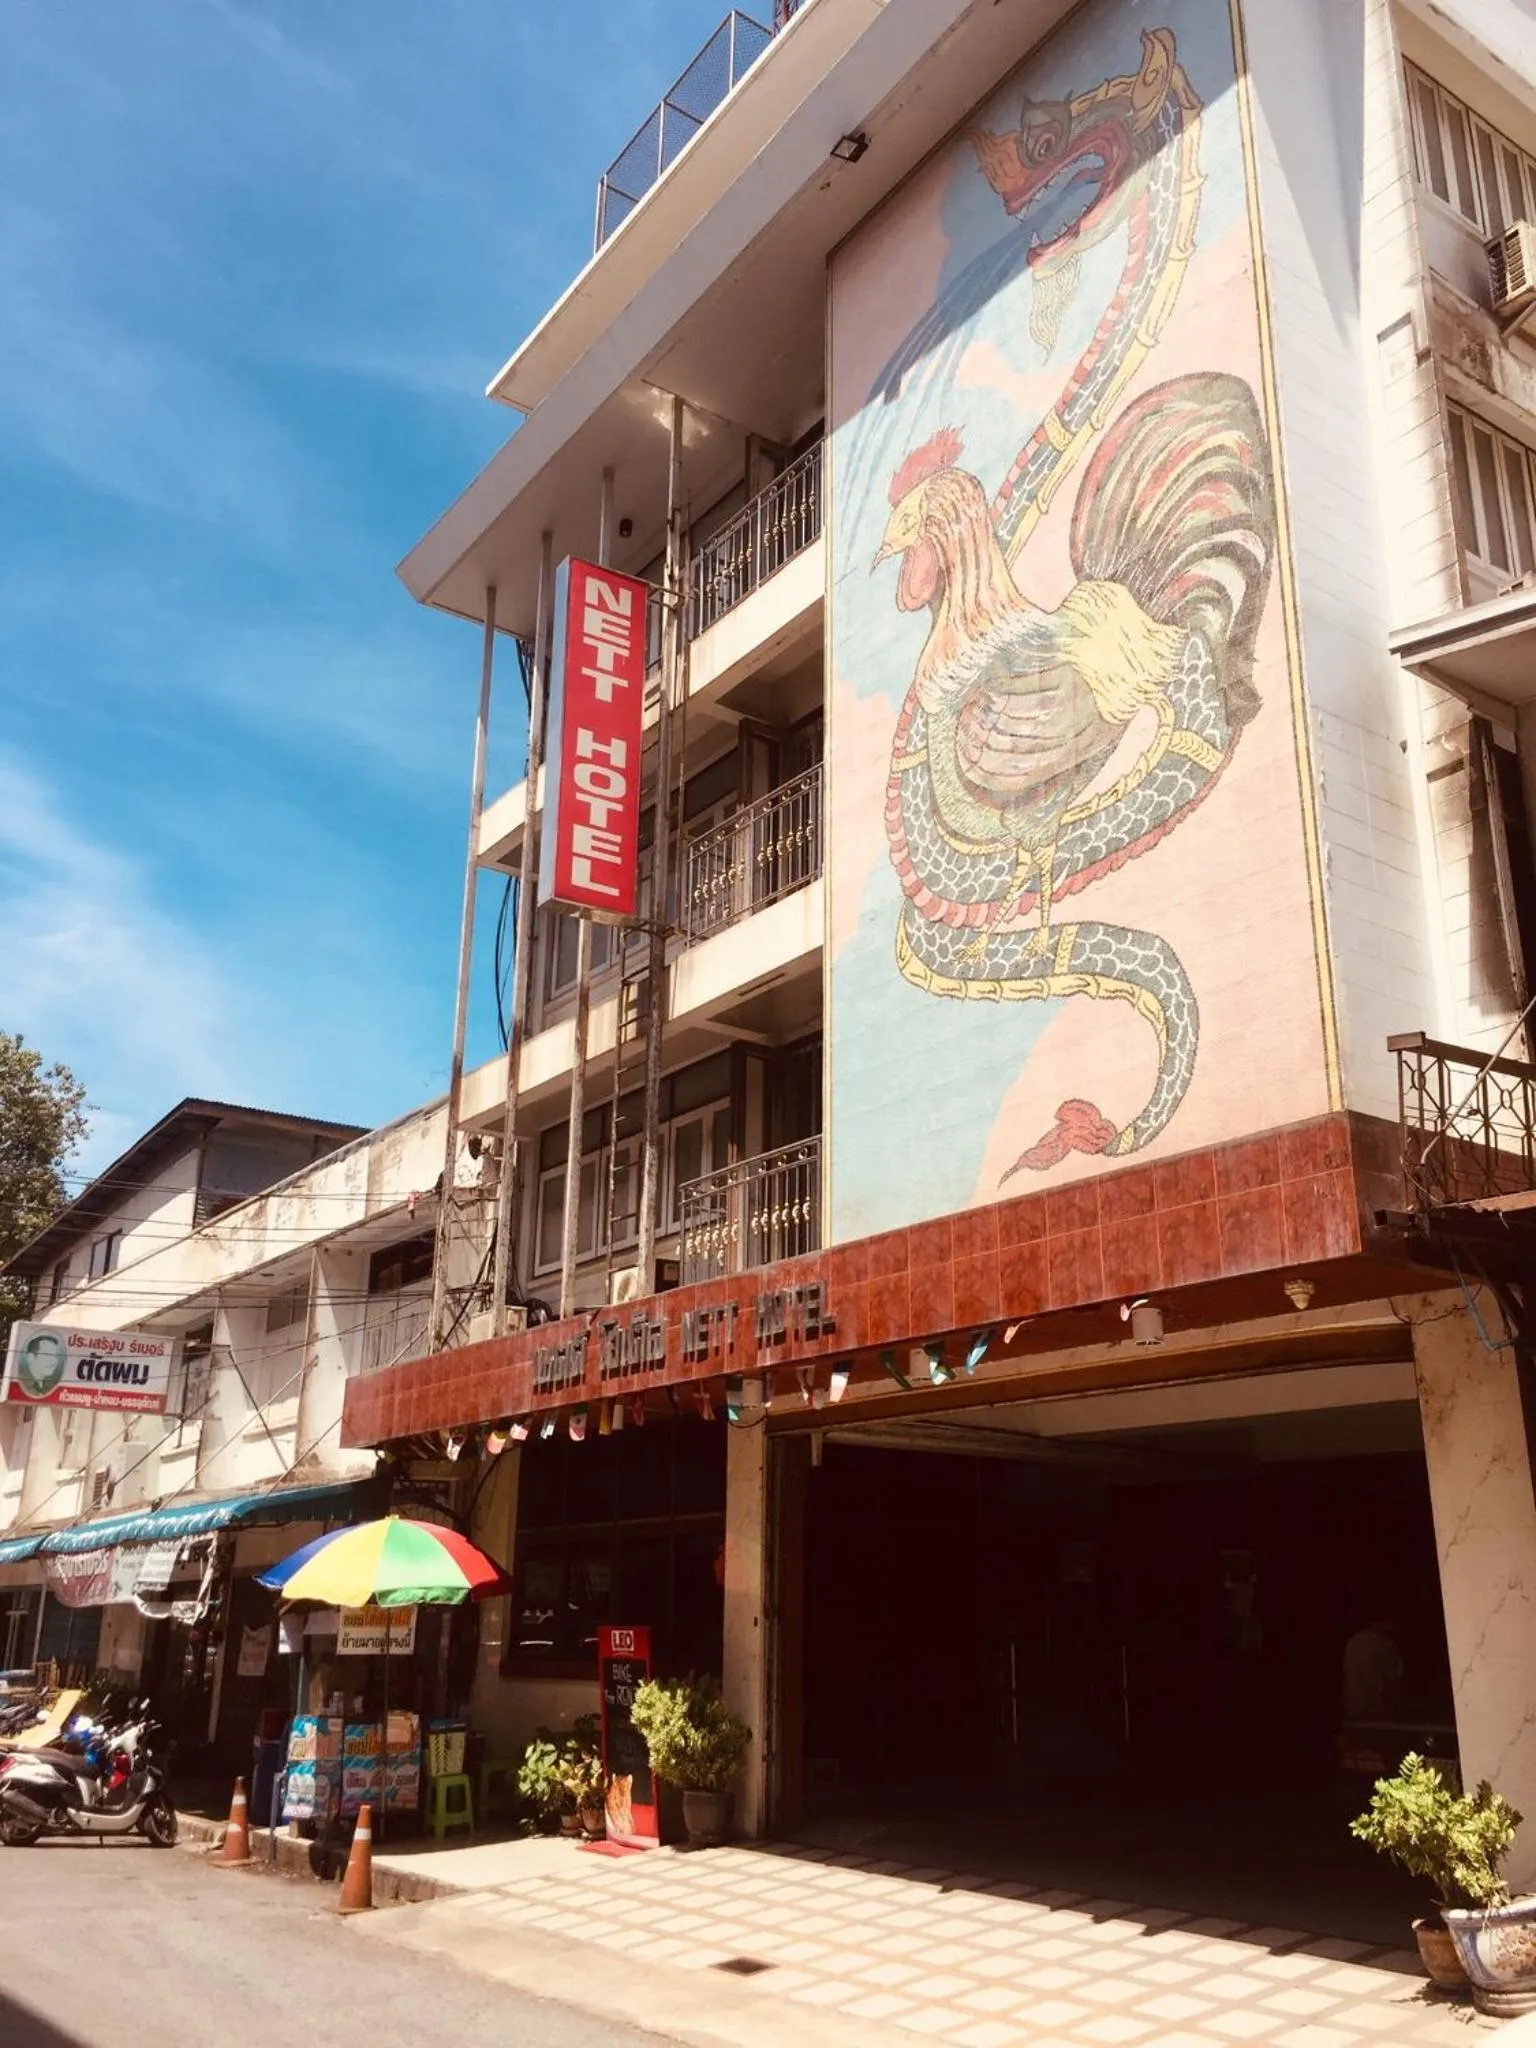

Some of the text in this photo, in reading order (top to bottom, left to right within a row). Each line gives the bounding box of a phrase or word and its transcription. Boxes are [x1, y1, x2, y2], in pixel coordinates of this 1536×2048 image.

[570, 575, 633, 897] NETT HOTEL
[681, 1302, 738, 1358] NETT
[76, 1353, 150, 1386] ตัดผม
[612, 1631, 633, 1649] LEO
